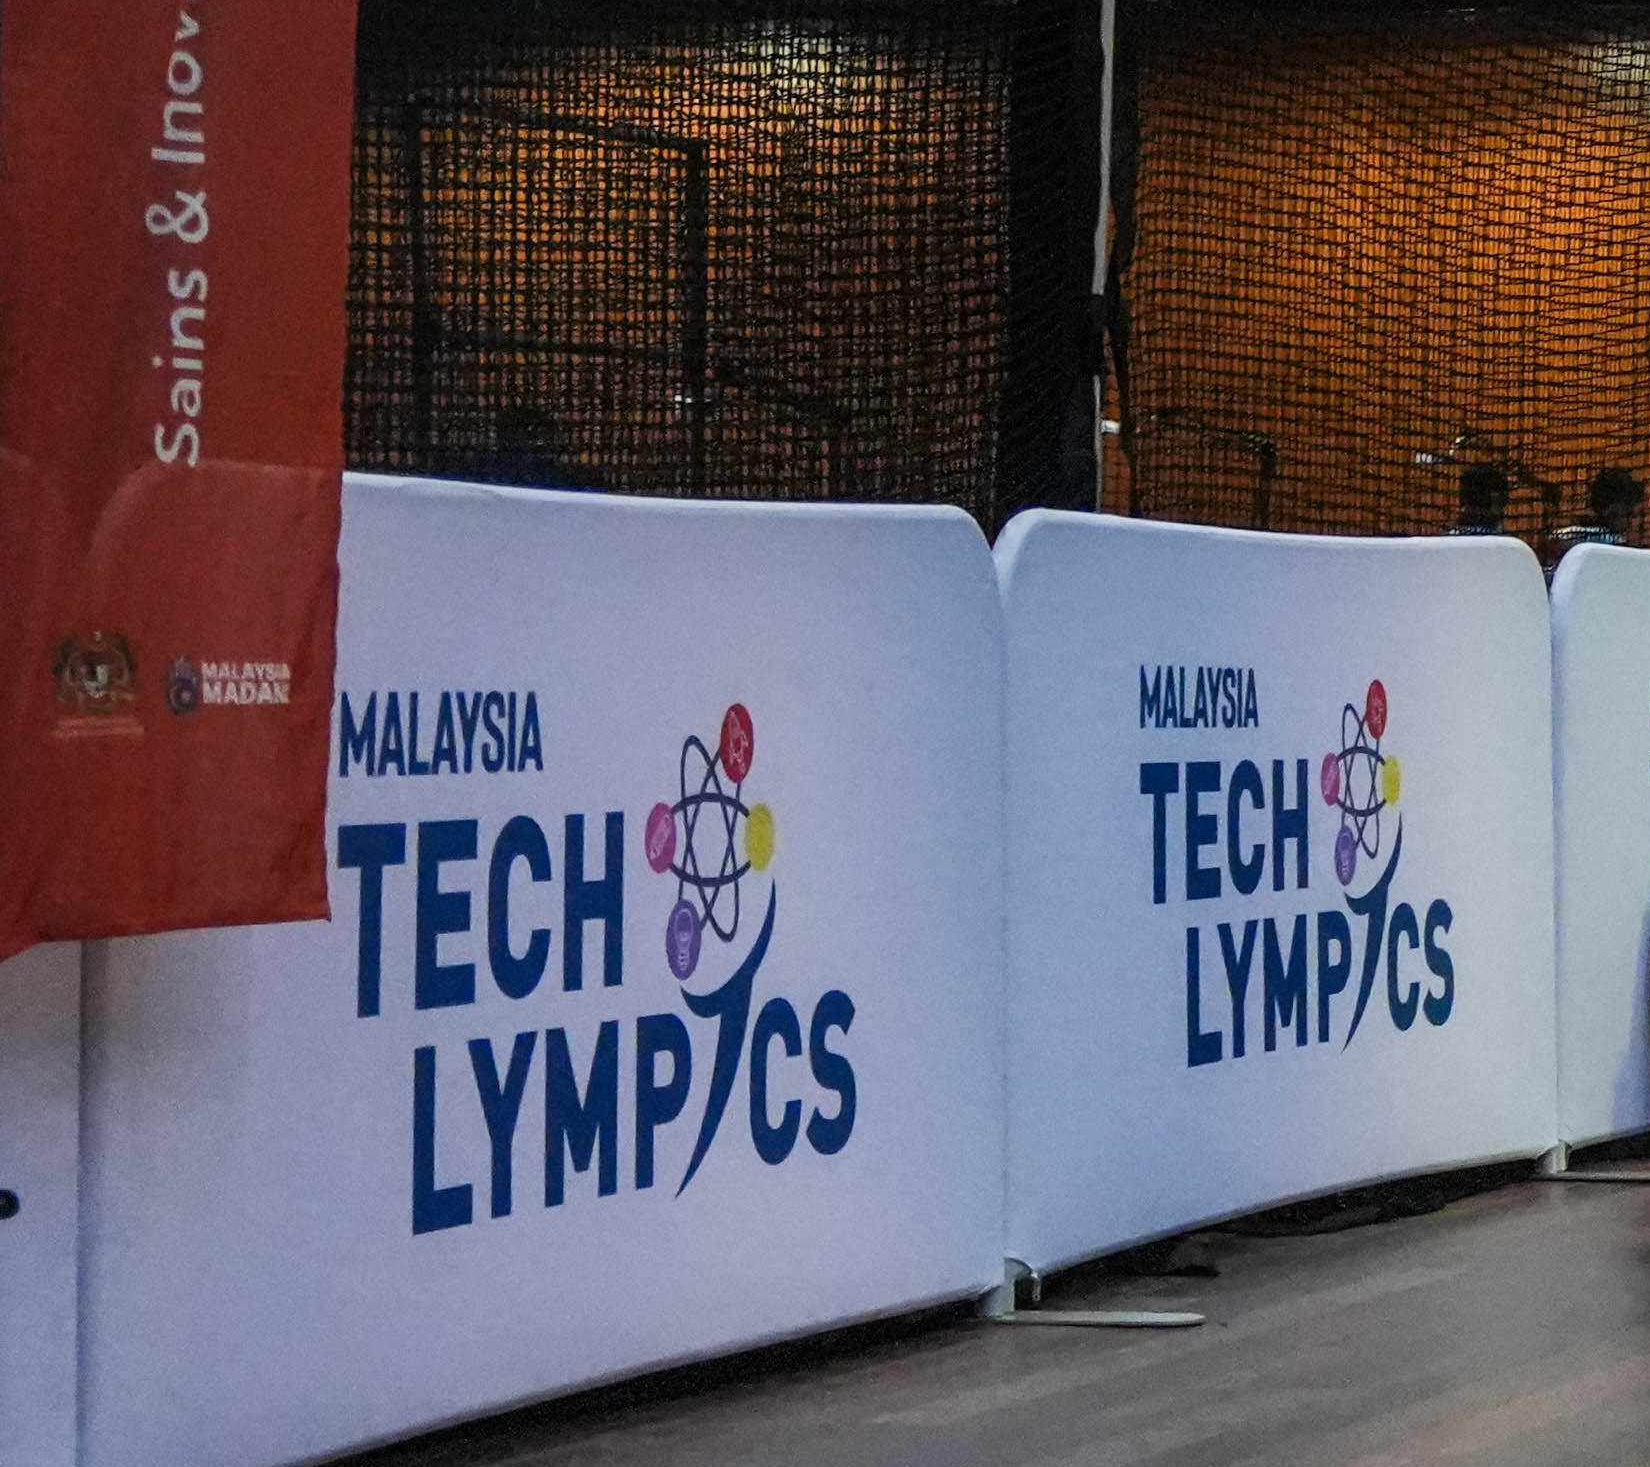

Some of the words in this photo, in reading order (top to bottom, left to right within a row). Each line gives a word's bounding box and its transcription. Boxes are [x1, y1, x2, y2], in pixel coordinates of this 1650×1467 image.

[145, 190, 209, 244] &
[152, 268, 208, 468] Sains
[201, 661, 291, 682] MALAYSIA
[338, 690, 544, 779] MALAYSIA
[1138, 664, 1259, 730] MALAYSIA
[1139, 758, 1310, 906] TECH
[337, 811, 625, 1018] TECH
[1186, 888, 1455, 1068] LYMPICS
[411, 978, 858, 1236] LYMPICS
